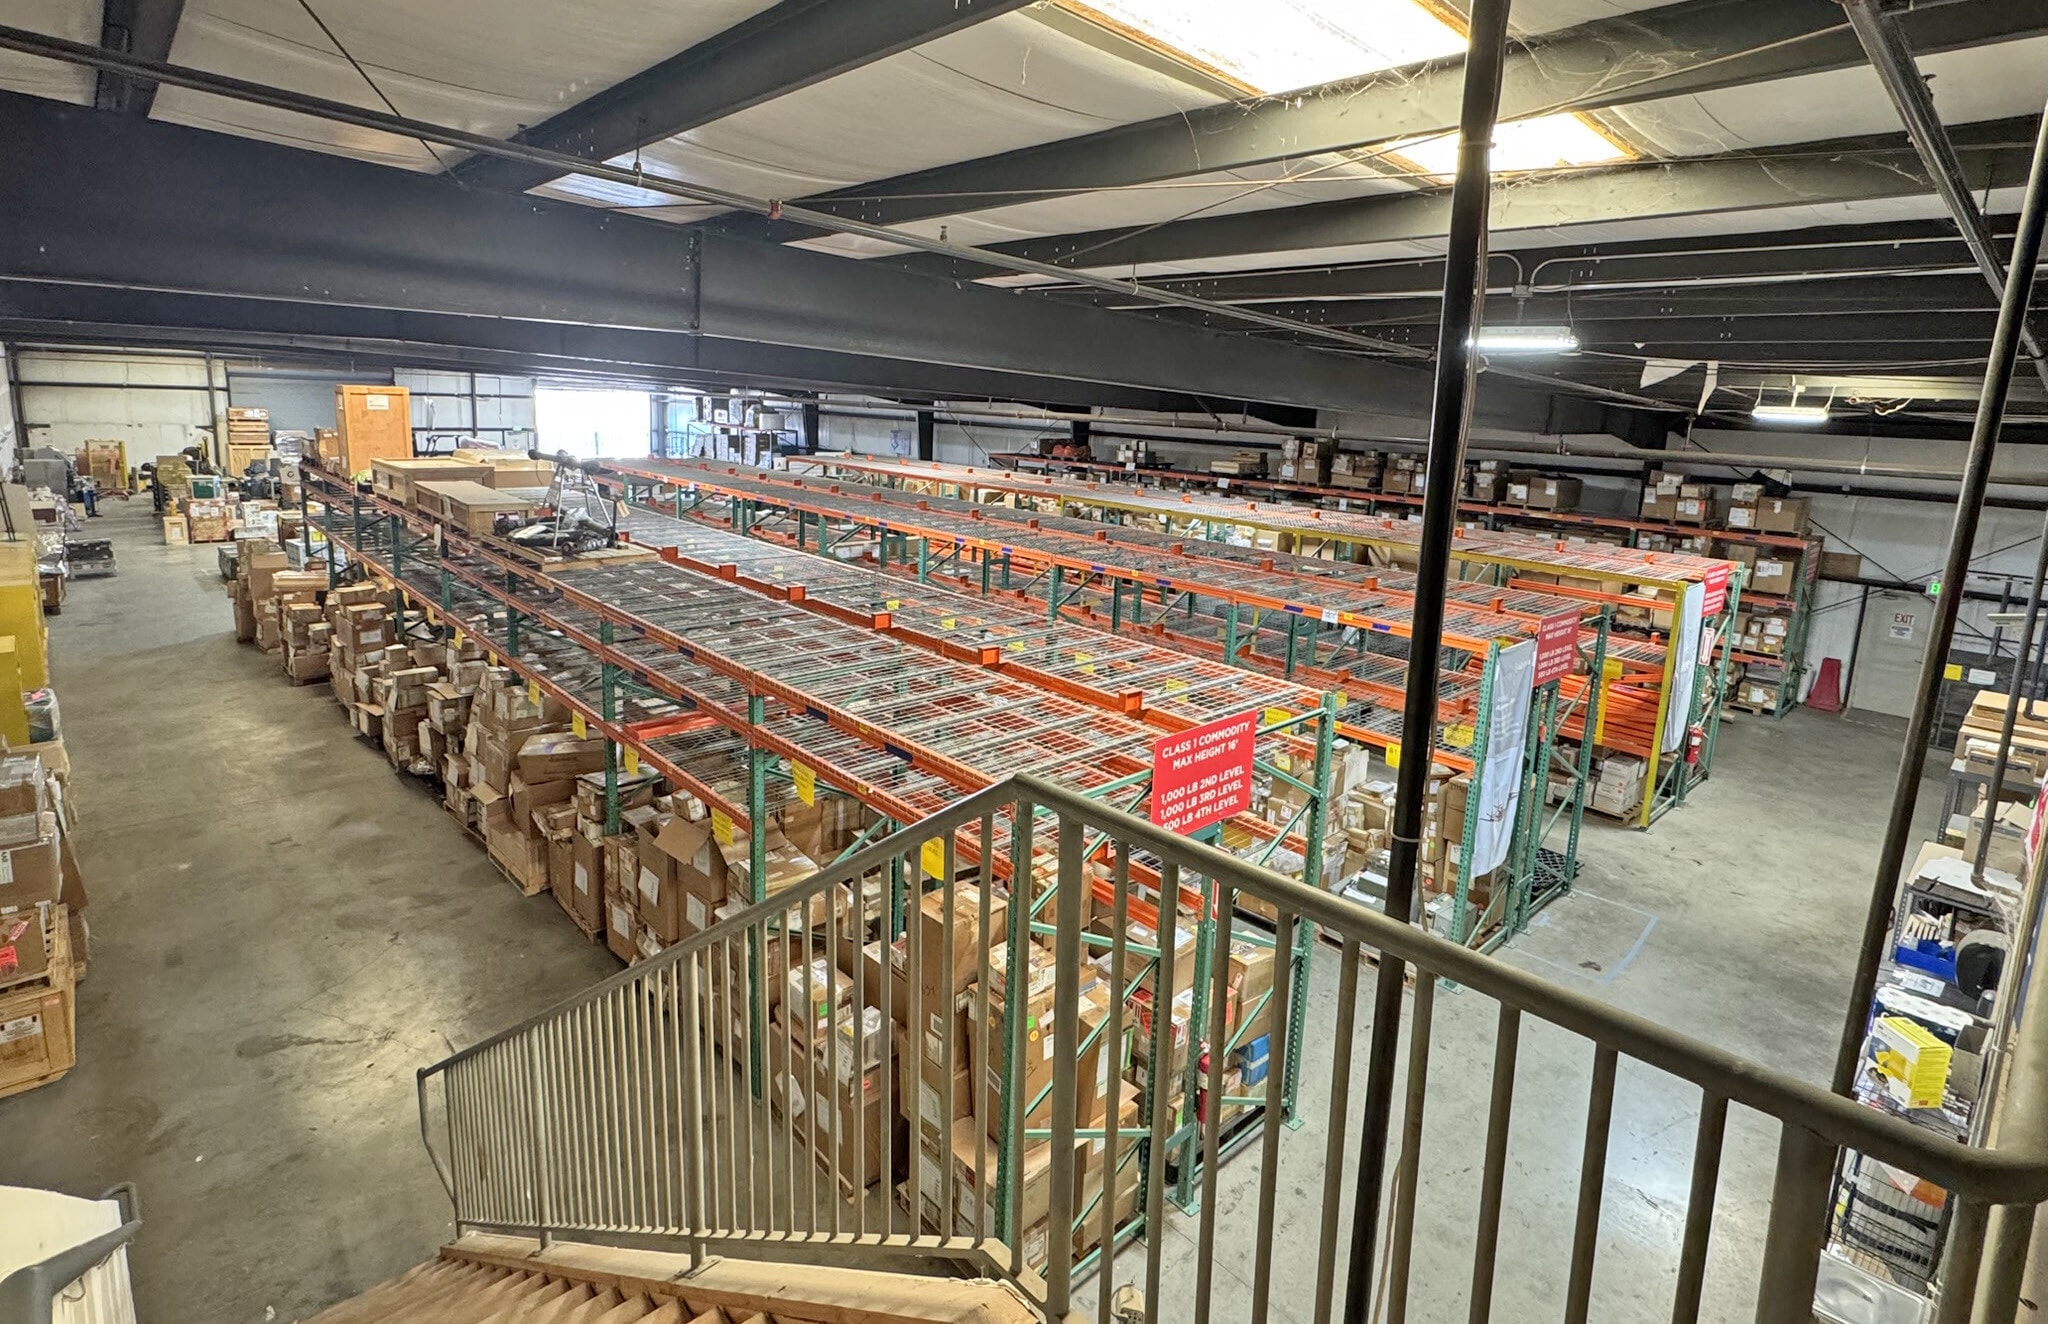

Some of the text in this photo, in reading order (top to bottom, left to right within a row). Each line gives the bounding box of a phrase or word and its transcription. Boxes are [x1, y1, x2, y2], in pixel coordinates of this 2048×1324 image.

[1894, 612, 1914, 624] EXIT
[1162, 721, 1250, 759] CLASS 1 COMMODITY
[1172, 756, 1193, 770] MAX
[1194, 743, 1226, 763] HEIGHT
[1160, 765, 1244, 806] 1,000 LB 2ND LEVEL
[1160, 779, 1243, 820] 1,000 LB 3RD LEVEL
[1163, 795, 1239, 831] 500 LB 4TH LEVEL
